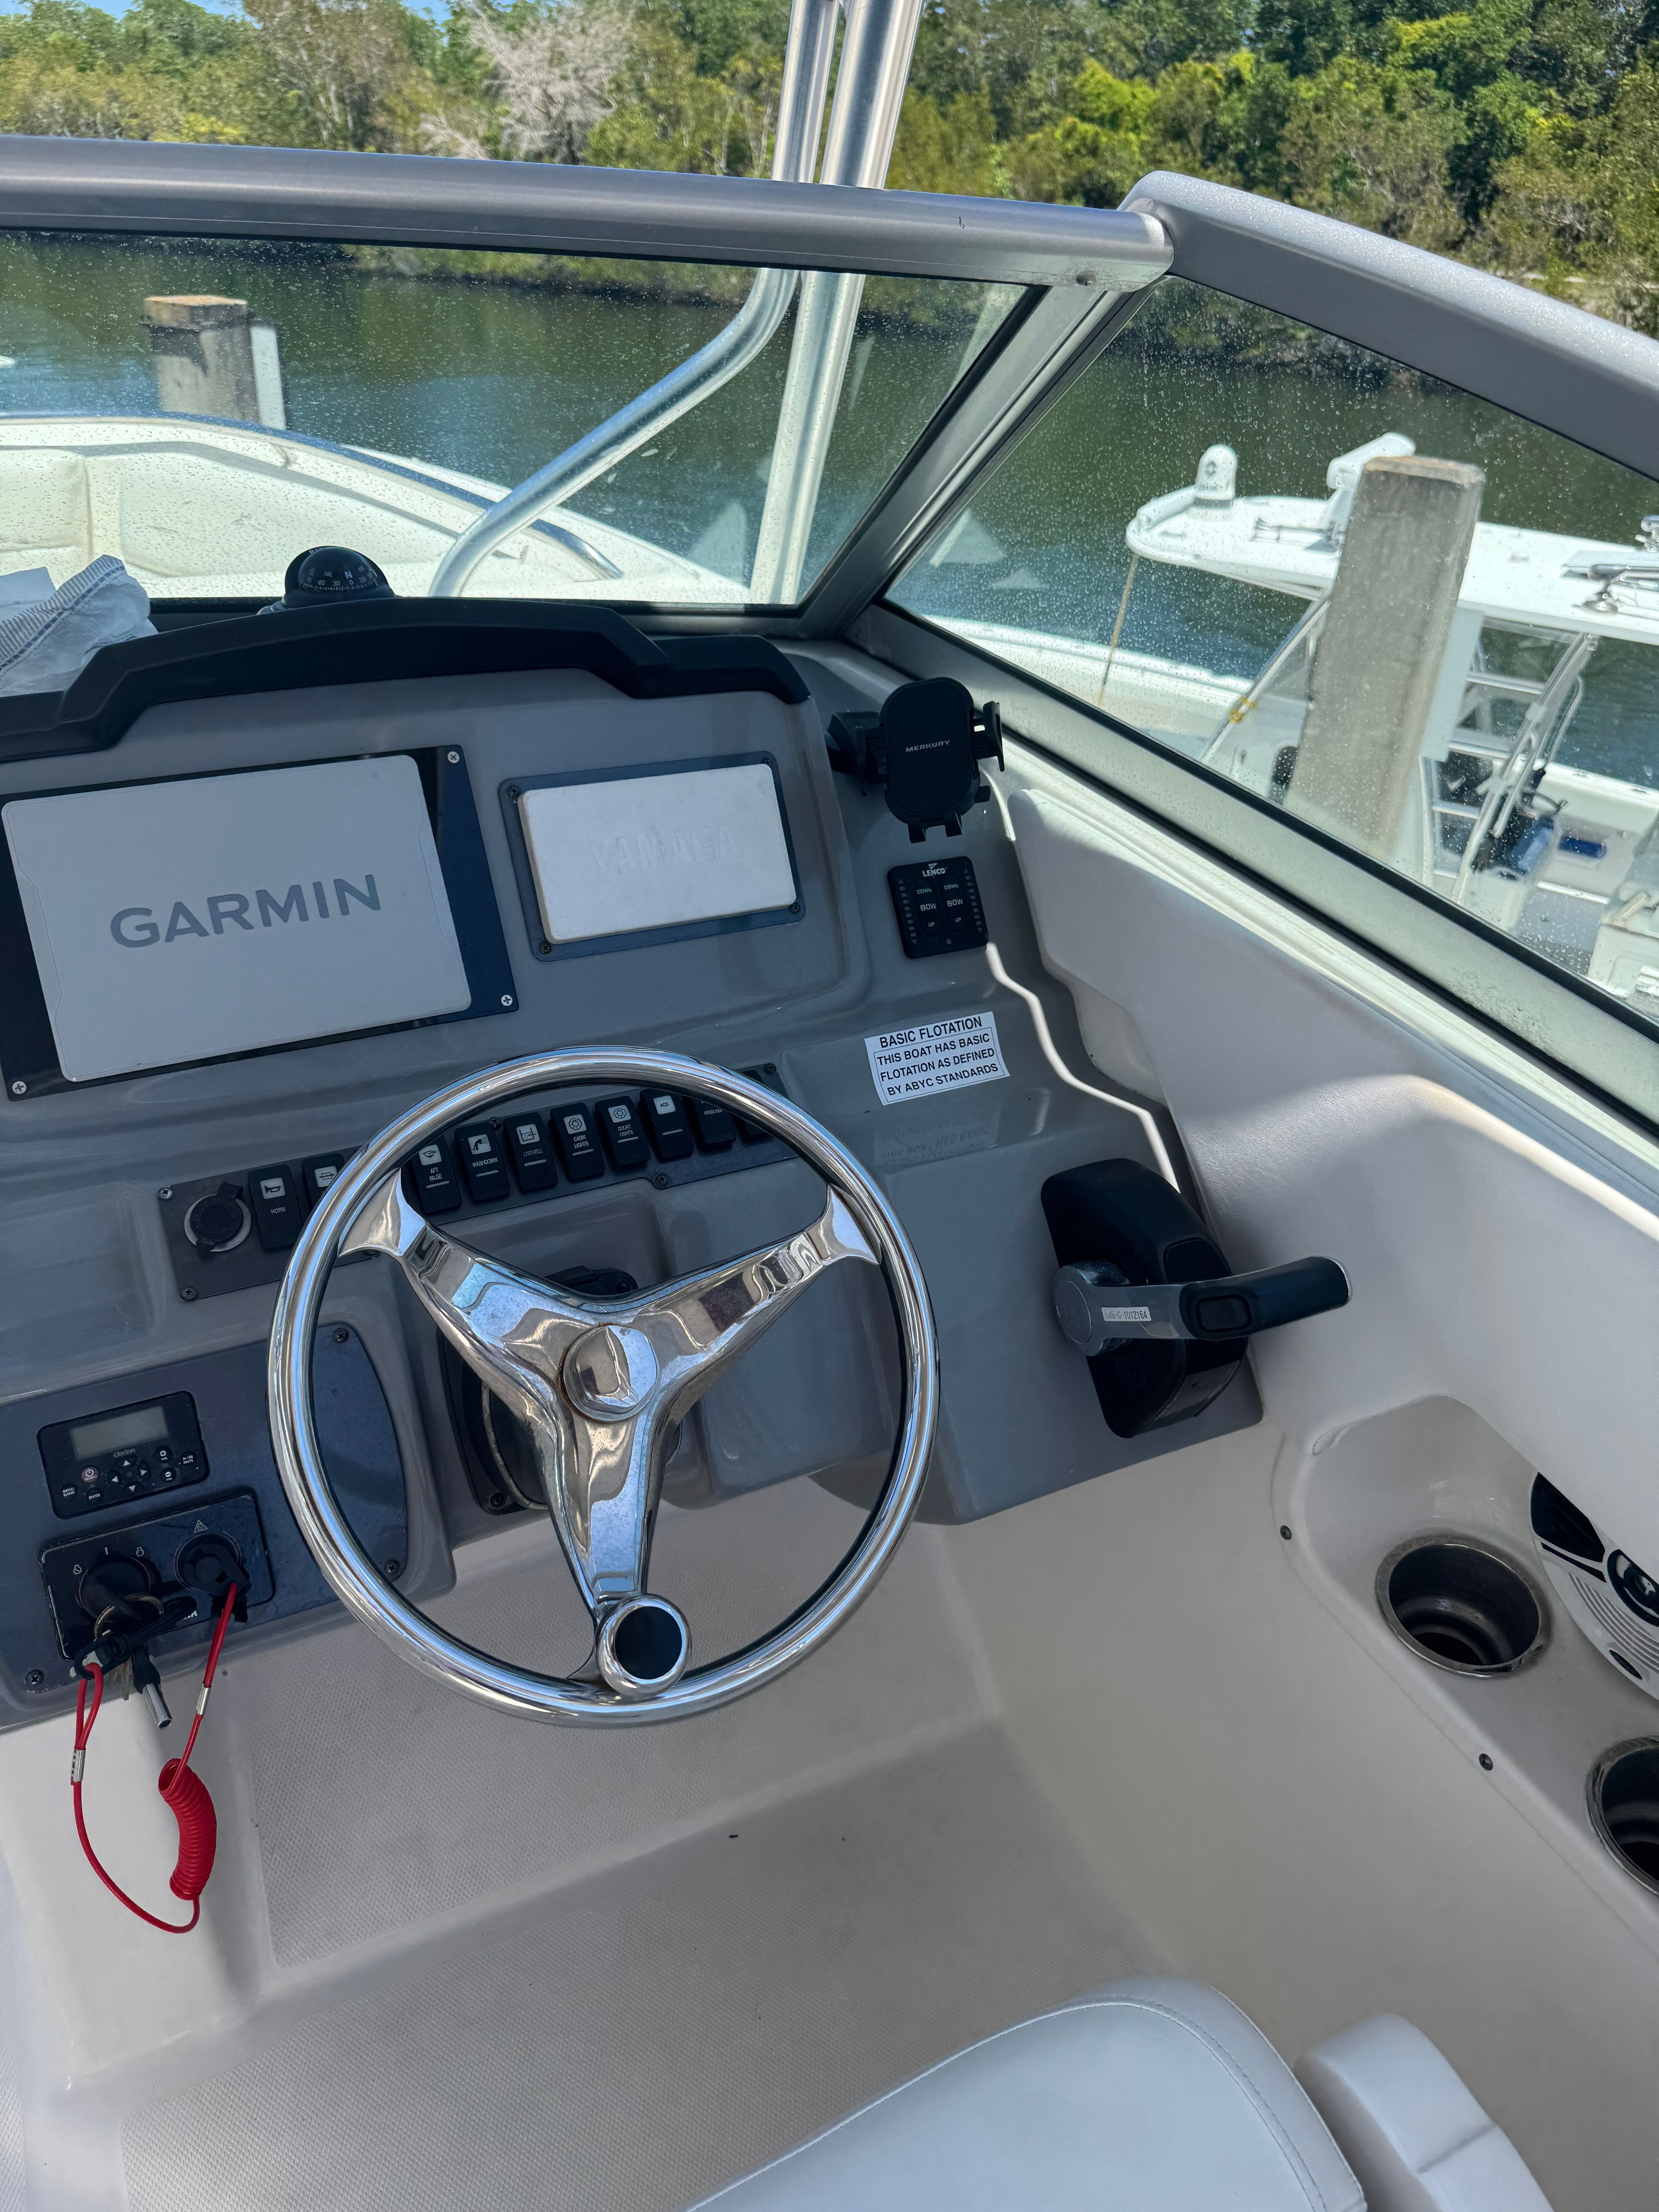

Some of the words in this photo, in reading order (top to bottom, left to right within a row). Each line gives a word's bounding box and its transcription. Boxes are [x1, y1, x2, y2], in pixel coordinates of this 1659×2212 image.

[906, 740, 950, 752] MERKURY
[589, 823, 739, 874] YAMAHA
[922, 867, 946, 877] LENCO
[920, 903, 936, 911] BOW
[946, 899, 963, 907] BOW
[111, 874, 381, 948] GARMIN
[879, 1031, 916, 1048] BASIC
[919, 1016, 982, 1039] FLOTATION
[877, 1053, 902, 1065] THIS
[904, 1046, 932, 1060] BOAT
[935, 1041, 956, 1053] HAS
[959, 1033, 989, 1048] BASIC
[880, 1061, 935, 1081] FLOTATION
[938, 1058, 951, 1069] AS
[953, 1048, 994, 1065] DEFINED
[887, 1085, 902, 1096] BY
[905, 1078, 934, 1092] ABYC
[935, 1063, 998, 1084] STANDARDS
[524, 1148, 543, 1157] LIVEWELL
[472, 1157, 498, 1168] WASHDOWN
[271, 1206, 286, 1214] HORN
